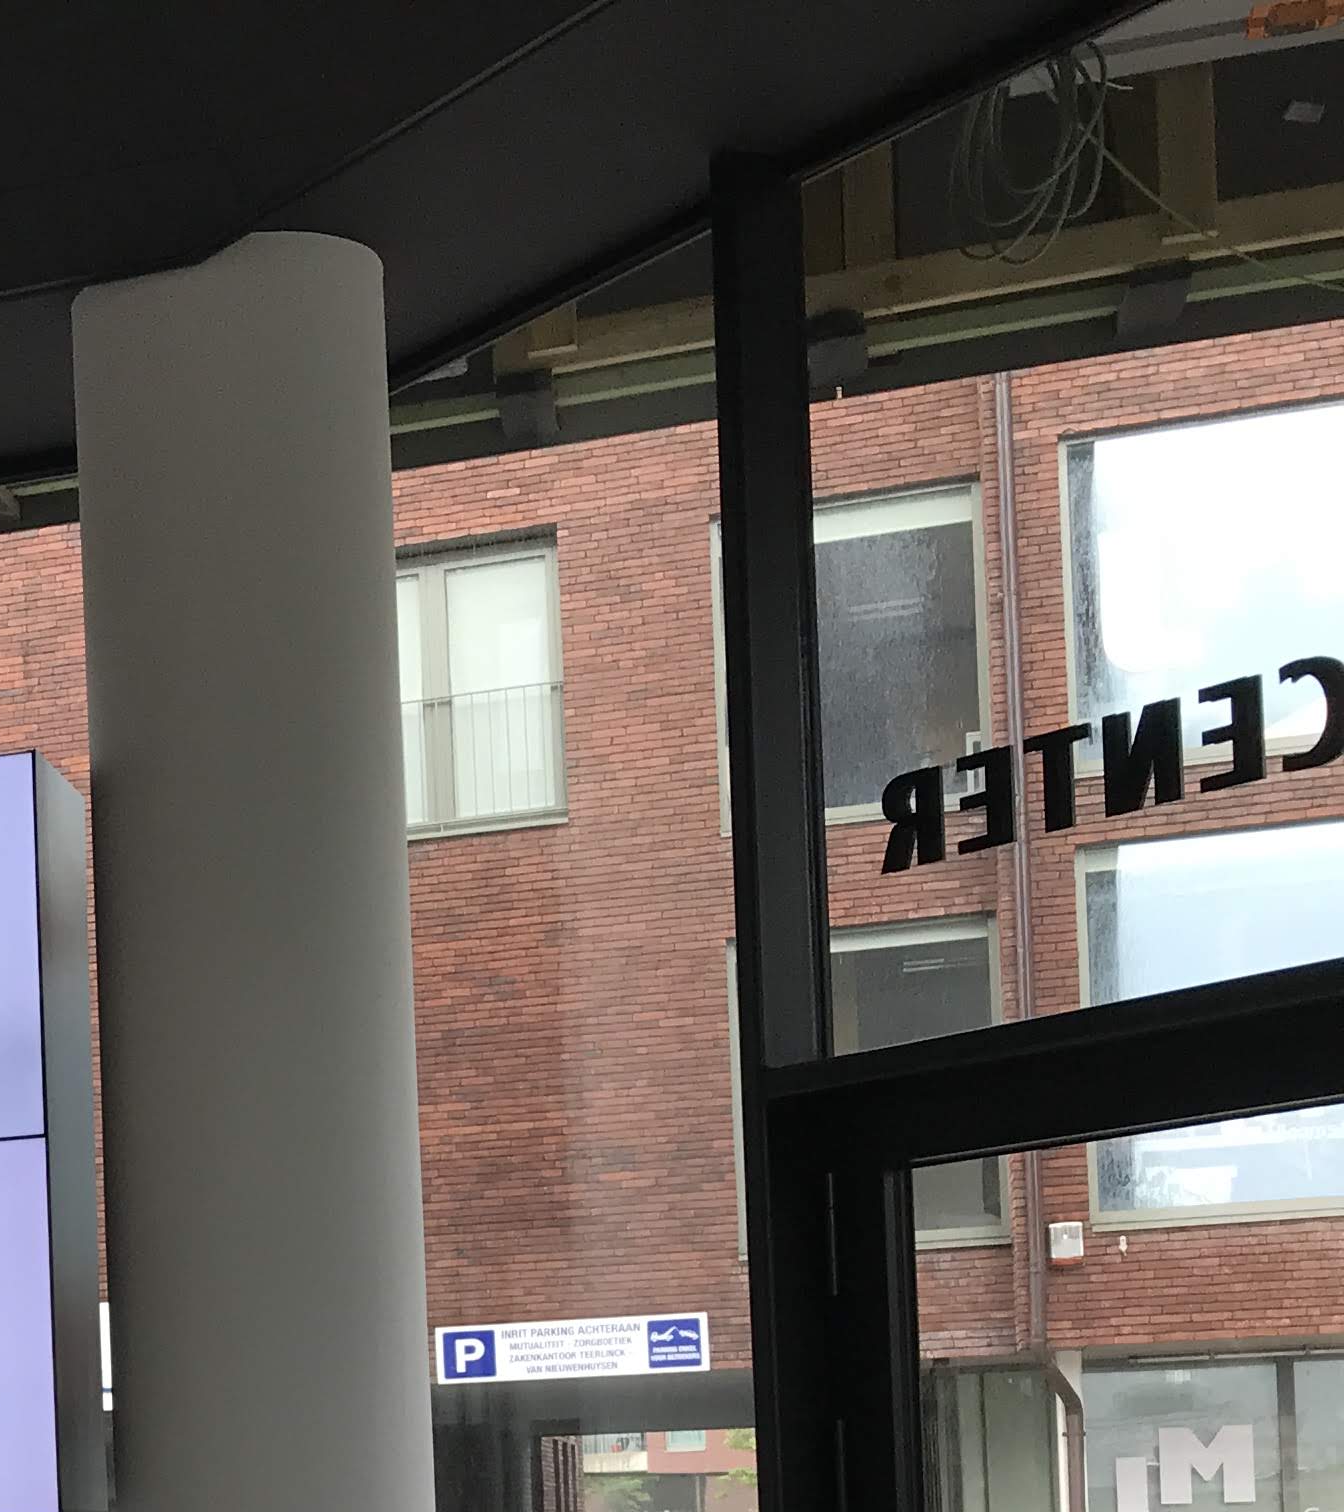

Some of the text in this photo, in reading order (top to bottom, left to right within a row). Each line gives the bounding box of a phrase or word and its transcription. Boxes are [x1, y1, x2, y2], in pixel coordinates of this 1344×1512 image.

[501, 1323, 641, 1340] INRIT PARKING ACHTERAAN
[455, 1338, 486, 1373] P
[526, 1365, 543, 1374] VAN
